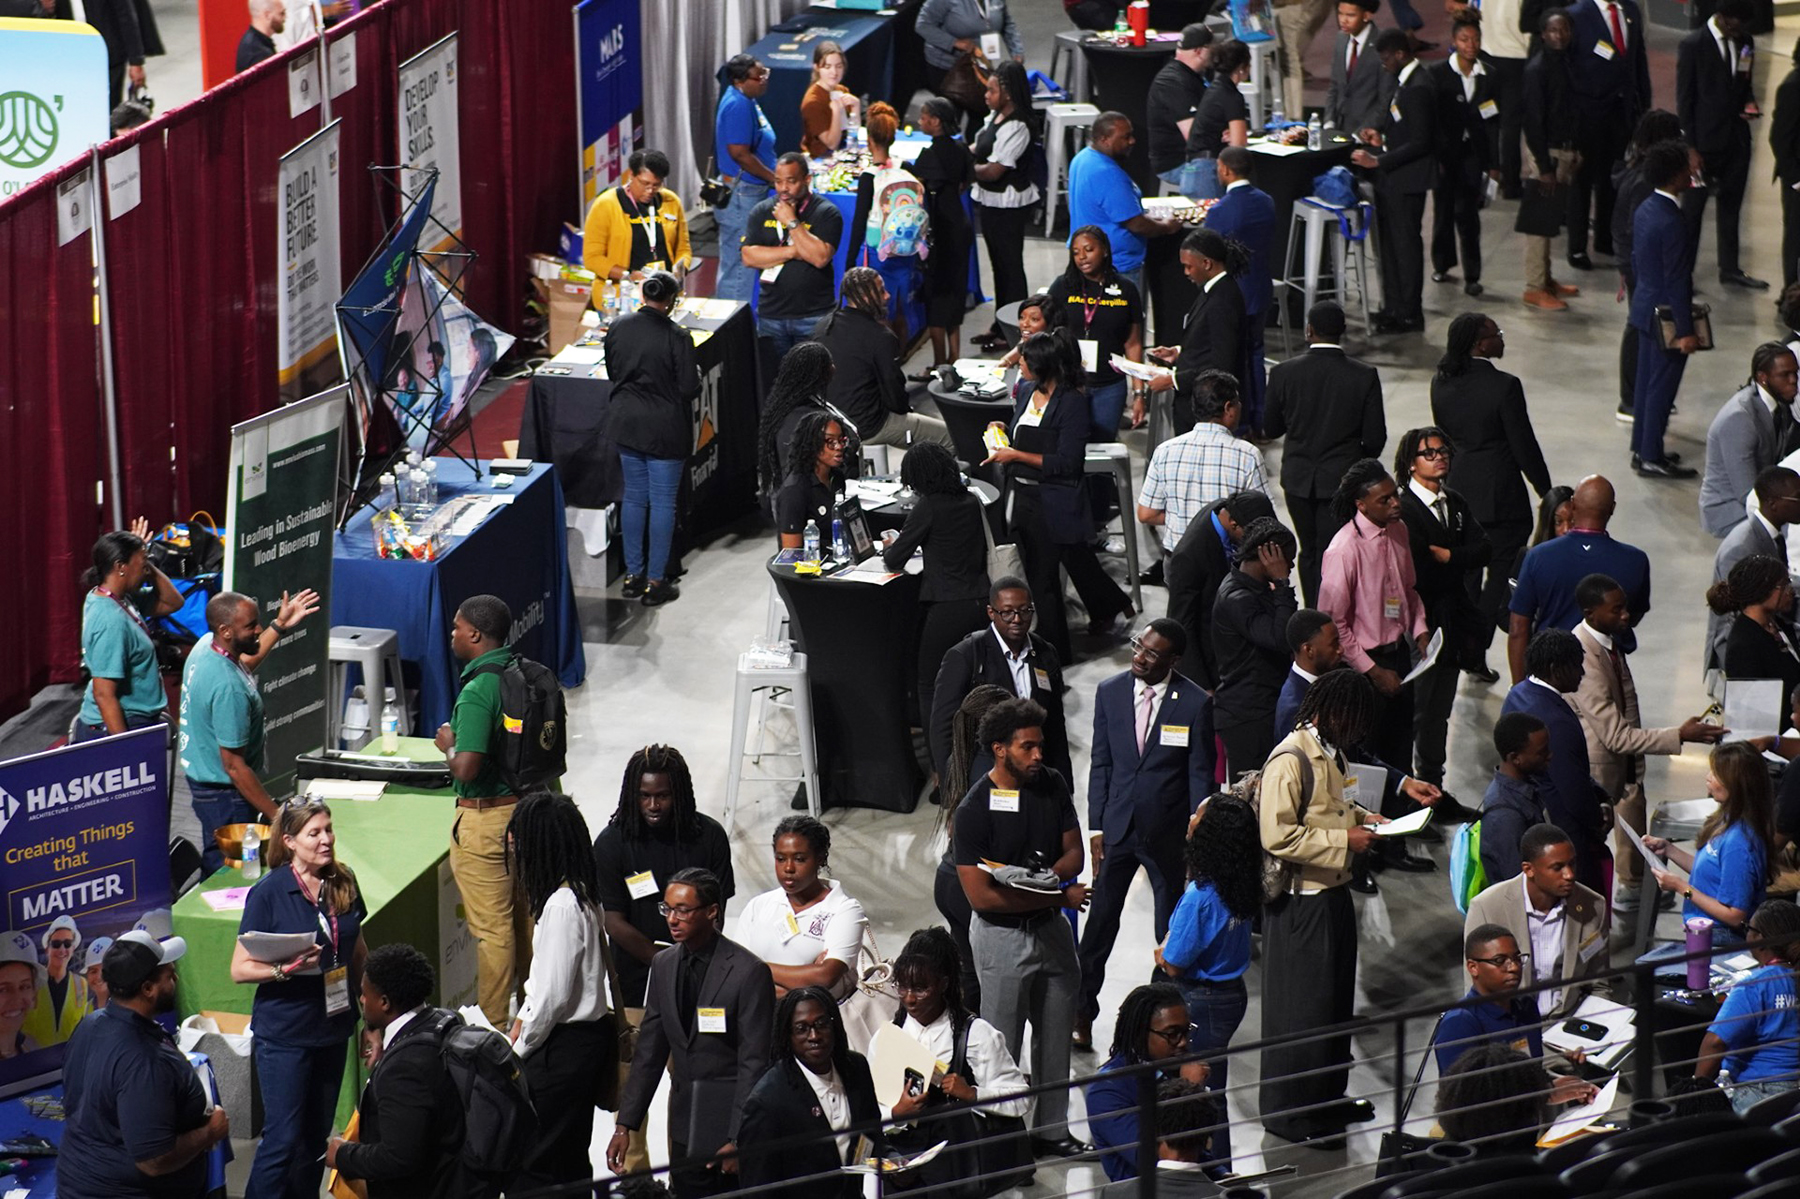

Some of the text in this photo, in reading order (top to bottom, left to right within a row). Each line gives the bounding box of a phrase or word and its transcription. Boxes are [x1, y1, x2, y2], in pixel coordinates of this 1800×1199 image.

[405, 71, 439, 112] DEVELOP
[406, 104, 428, 137] YOUR
[286, 165, 318, 208] BUILD A
[286, 193, 316, 236] BETTER
[240, 499, 334, 549] Leading in Sustainable
[253, 529, 321, 567] Wood Bioenergy
[281, 635, 294, 647] more
[294, 628, 307, 641] trees
[263, 663, 317, 693] Fight climate change
[276, 711, 293, 727] strong
[293, 698, 325, 720] communities
[27, 762, 156, 813] HASKELL
[28, 785, 156, 821] ARCHITECTURE ENGINEERING CONSTRUCTION
[5, 820, 135, 864] Creating Things
[53, 850, 90, 872] that
[22, 873, 124, 921] MATTER
